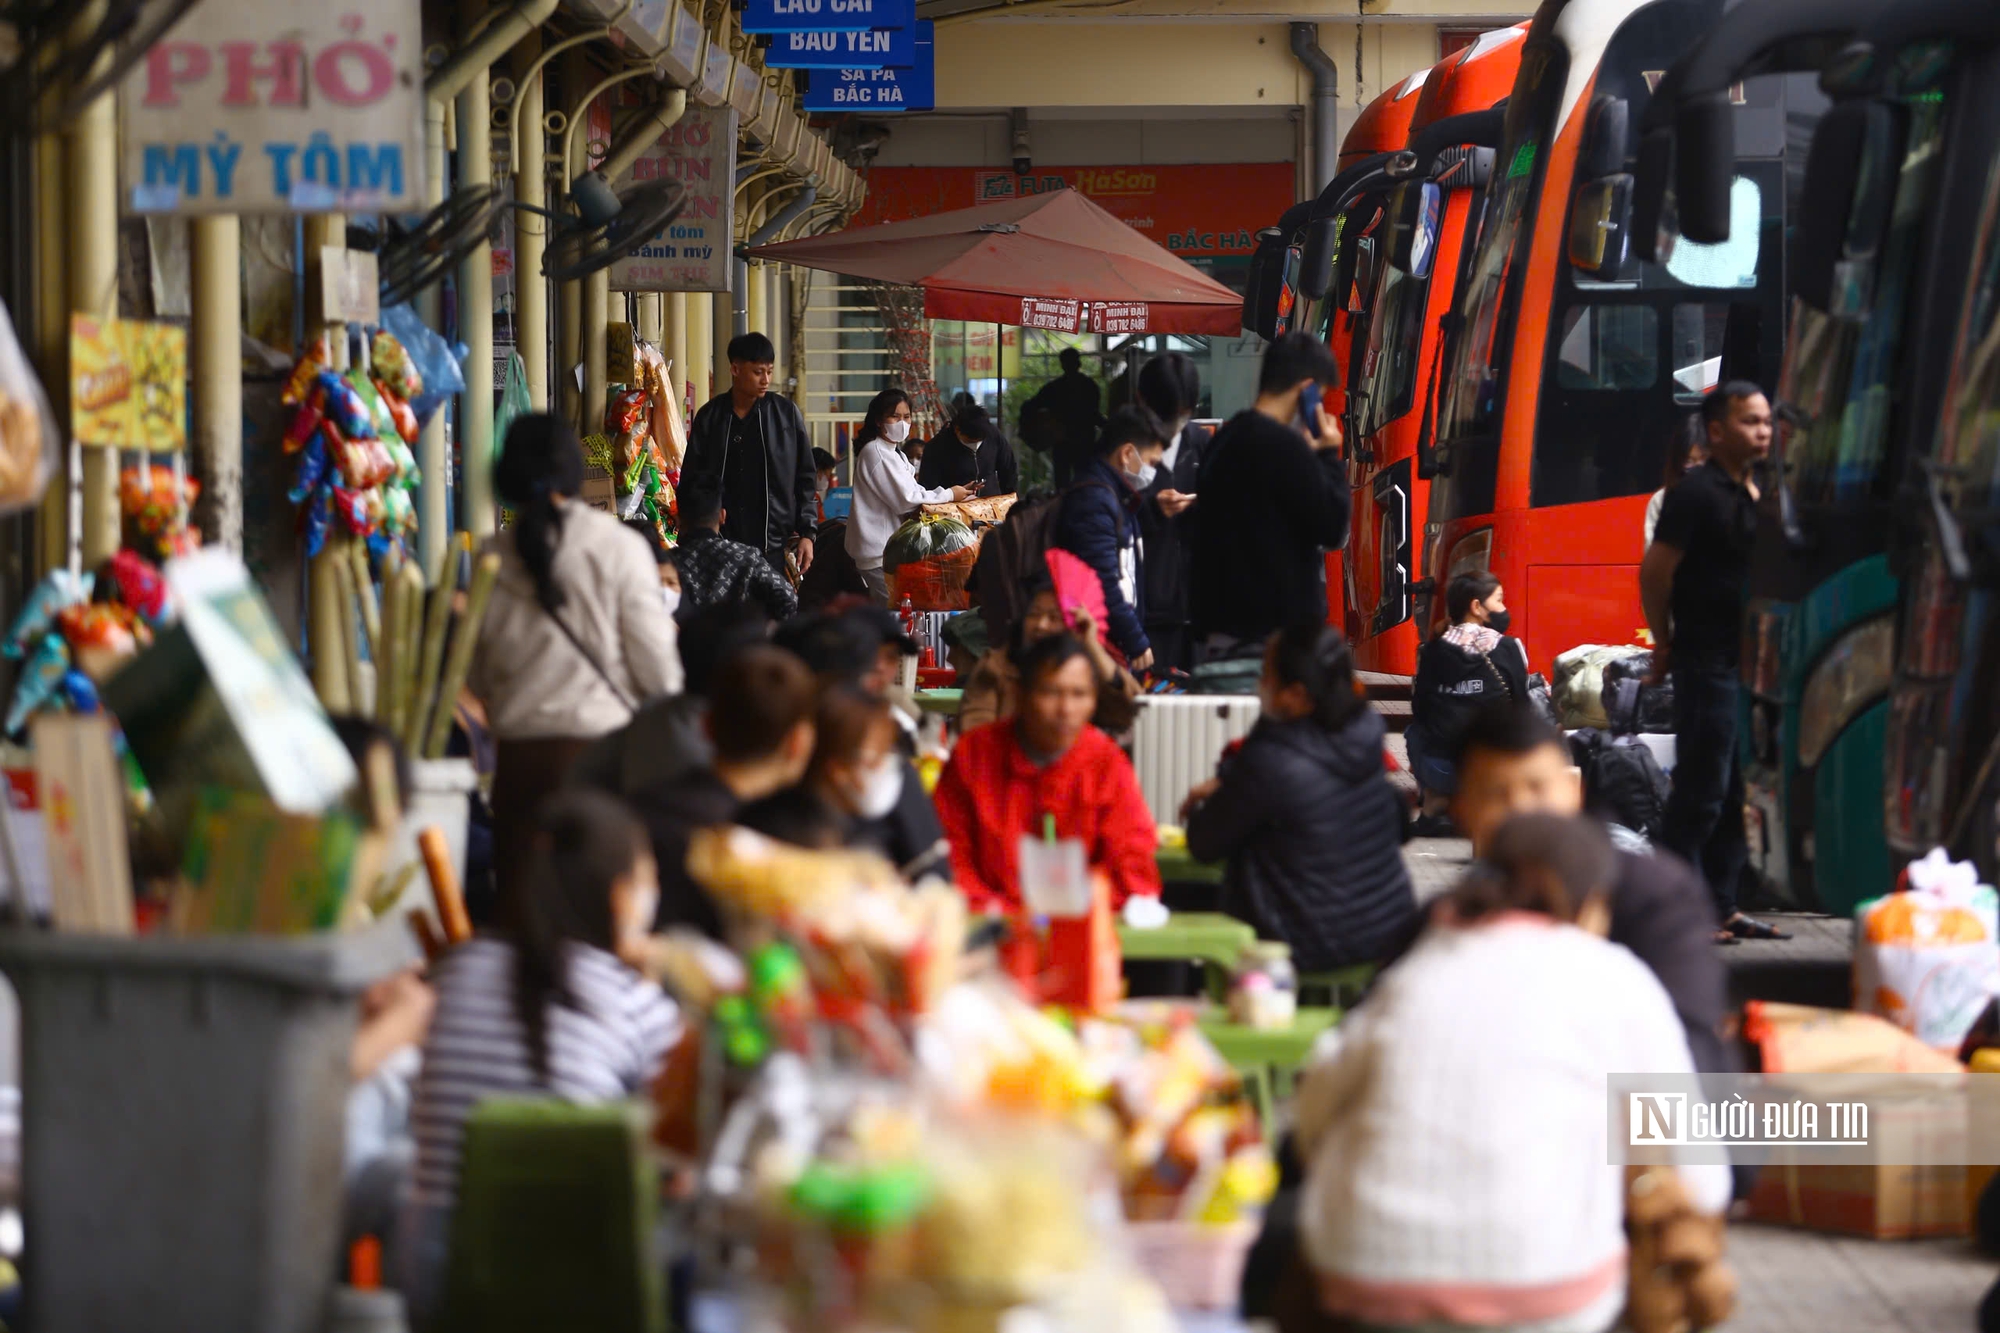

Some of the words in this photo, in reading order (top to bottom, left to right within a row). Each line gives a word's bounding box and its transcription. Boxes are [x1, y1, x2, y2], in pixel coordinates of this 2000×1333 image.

[142, 13, 396, 109] PHỞ
[841, 69, 865, 81] SA
[871, 69, 896, 81] PA
[833, 83, 871, 102] BẮC
[878, 85, 903, 102] HÀ
[262, 130, 404, 197] TÔM
[1020, 175, 1066, 195] FUTA
[670, 225, 704, 238] tôm
[1167, 228, 1215, 250] BẮC
[1219, 229, 1253, 249] HÀ
[628, 266, 663, 279] SIM
[1035, 303, 1058, 313] MINH
[1106, 308, 1129, 317] MINH
[1033, 314, 1046, 326] 039
[1106, 319, 1118, 332] 039
